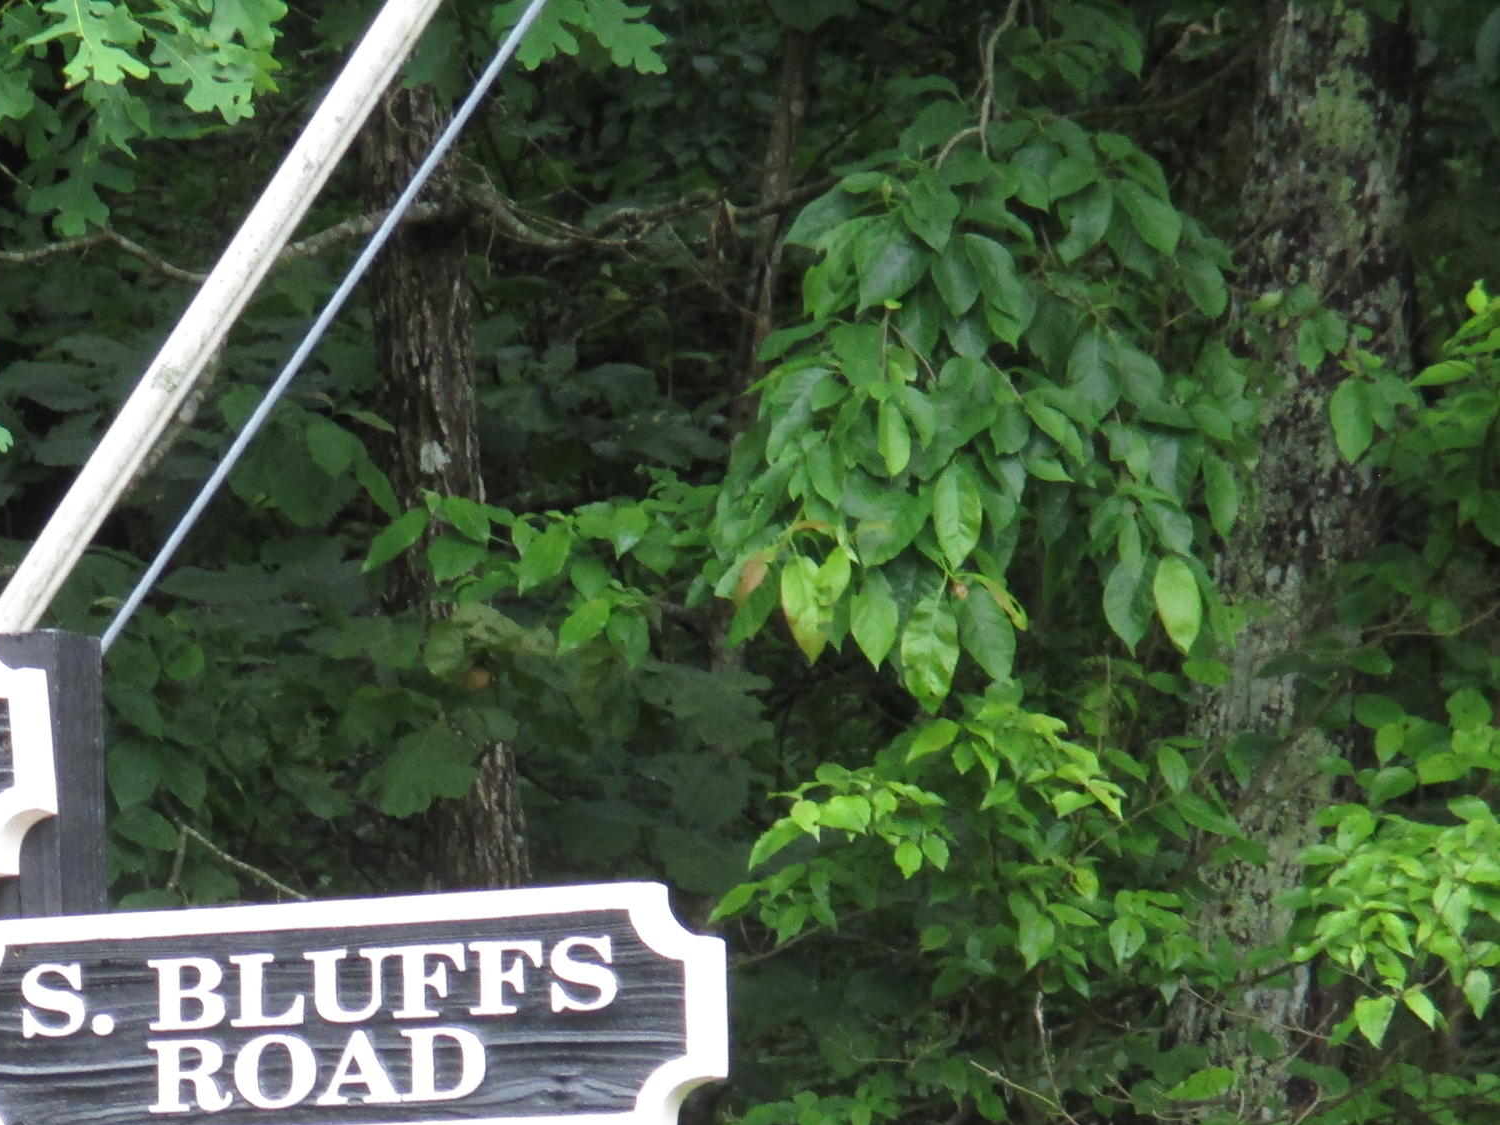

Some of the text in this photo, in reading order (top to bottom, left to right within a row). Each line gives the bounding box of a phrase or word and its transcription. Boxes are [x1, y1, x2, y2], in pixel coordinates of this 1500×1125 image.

[20, 934, 620, 1039] S. BLUFFS
[147, 1025, 489, 1114] ROAD
